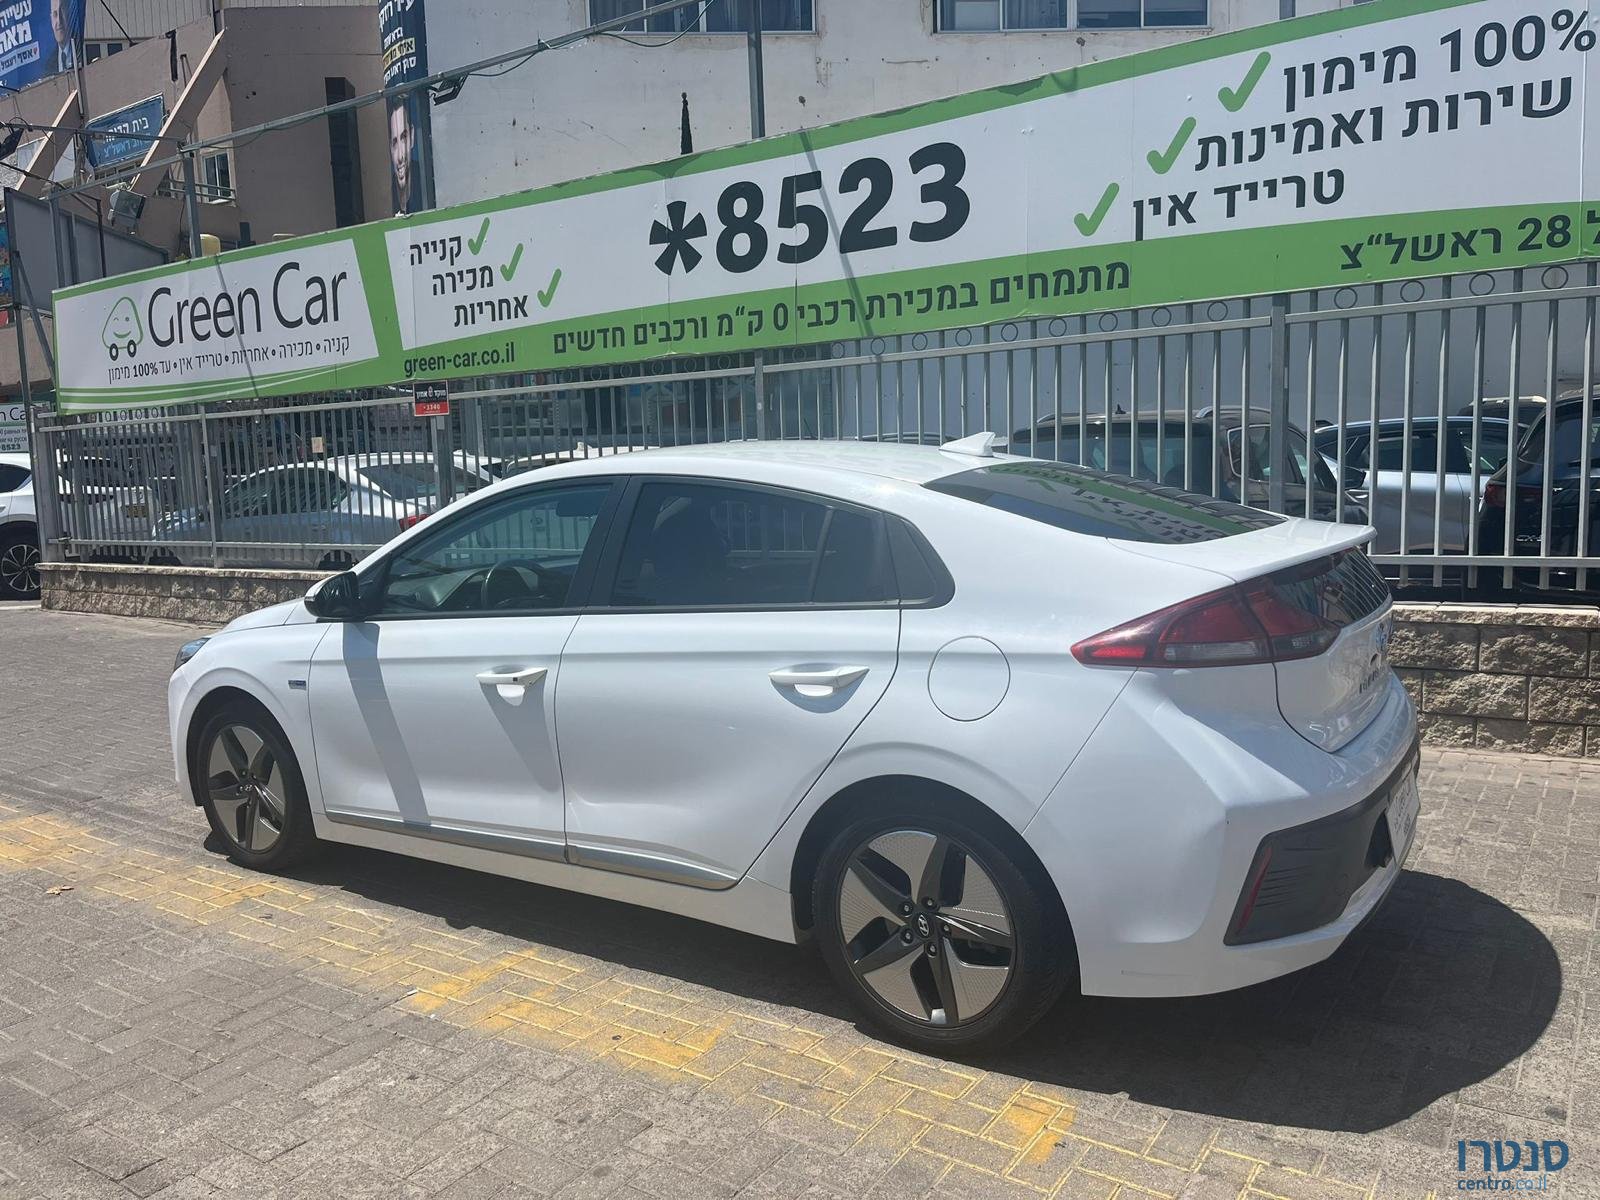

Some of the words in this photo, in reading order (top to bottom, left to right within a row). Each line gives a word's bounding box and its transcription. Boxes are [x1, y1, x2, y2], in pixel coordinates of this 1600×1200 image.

[1440, 8, 1599, 74] 100%
[1283, 45, 1417, 113] מימון
[1401, 76, 1573, 139] שירות
[1194, 105, 1384, 172] ואמינות
[1213, 168, 1346, 220] טרייד
[1132, 189, 1199, 242] אין
[1517, 214, 1572, 252] 28
[409, 235, 462, 266] קנייה
[432, 265, 494, 296] מכירה
[990, 261, 1130, 305] מתמחים
[148, 286, 262, 348] Green
[272, 261, 348, 329] Car
[454, 294, 529, 328] אחריות
[773, 302, 789, 331] 0
[796, 297, 857, 328] רכבי
[864, 282, 979, 321] במכירת
[323, 336, 350, 356] קניה
[553, 326, 625, 354] חדשים
[634, 315, 708, 346] ורכבים
[195, 352, 223, 369] טרייד
[231, 346, 269, 365] אחריות
[279, 340, 313, 359] מכירה
[404, 341, 516, 378] green-car.co.il
[108, 365, 131, 385] מימון
[133, 361, 159, 378] 100%
[159, 359, 171, 374] עד
[178, 356, 193, 375] אין
[10, 407, 26, 420] Ca
